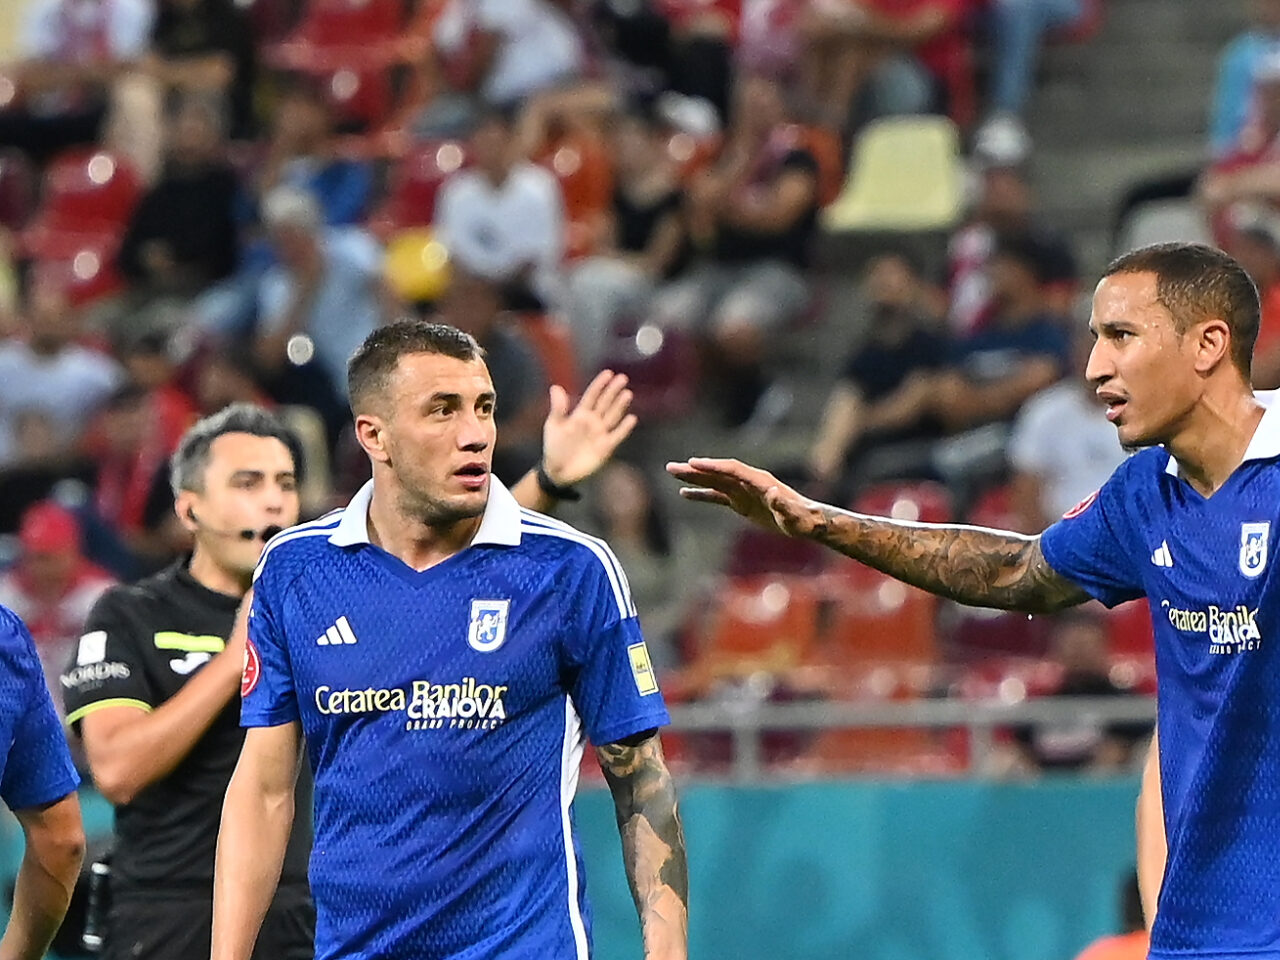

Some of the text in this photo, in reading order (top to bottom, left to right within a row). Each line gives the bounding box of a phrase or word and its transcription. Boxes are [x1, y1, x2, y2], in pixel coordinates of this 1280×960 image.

[1161, 599, 1207, 633] etatea
[315, 677, 508, 715] Cetatea Banilor
[407, 697, 507, 720] CRAIOVA
